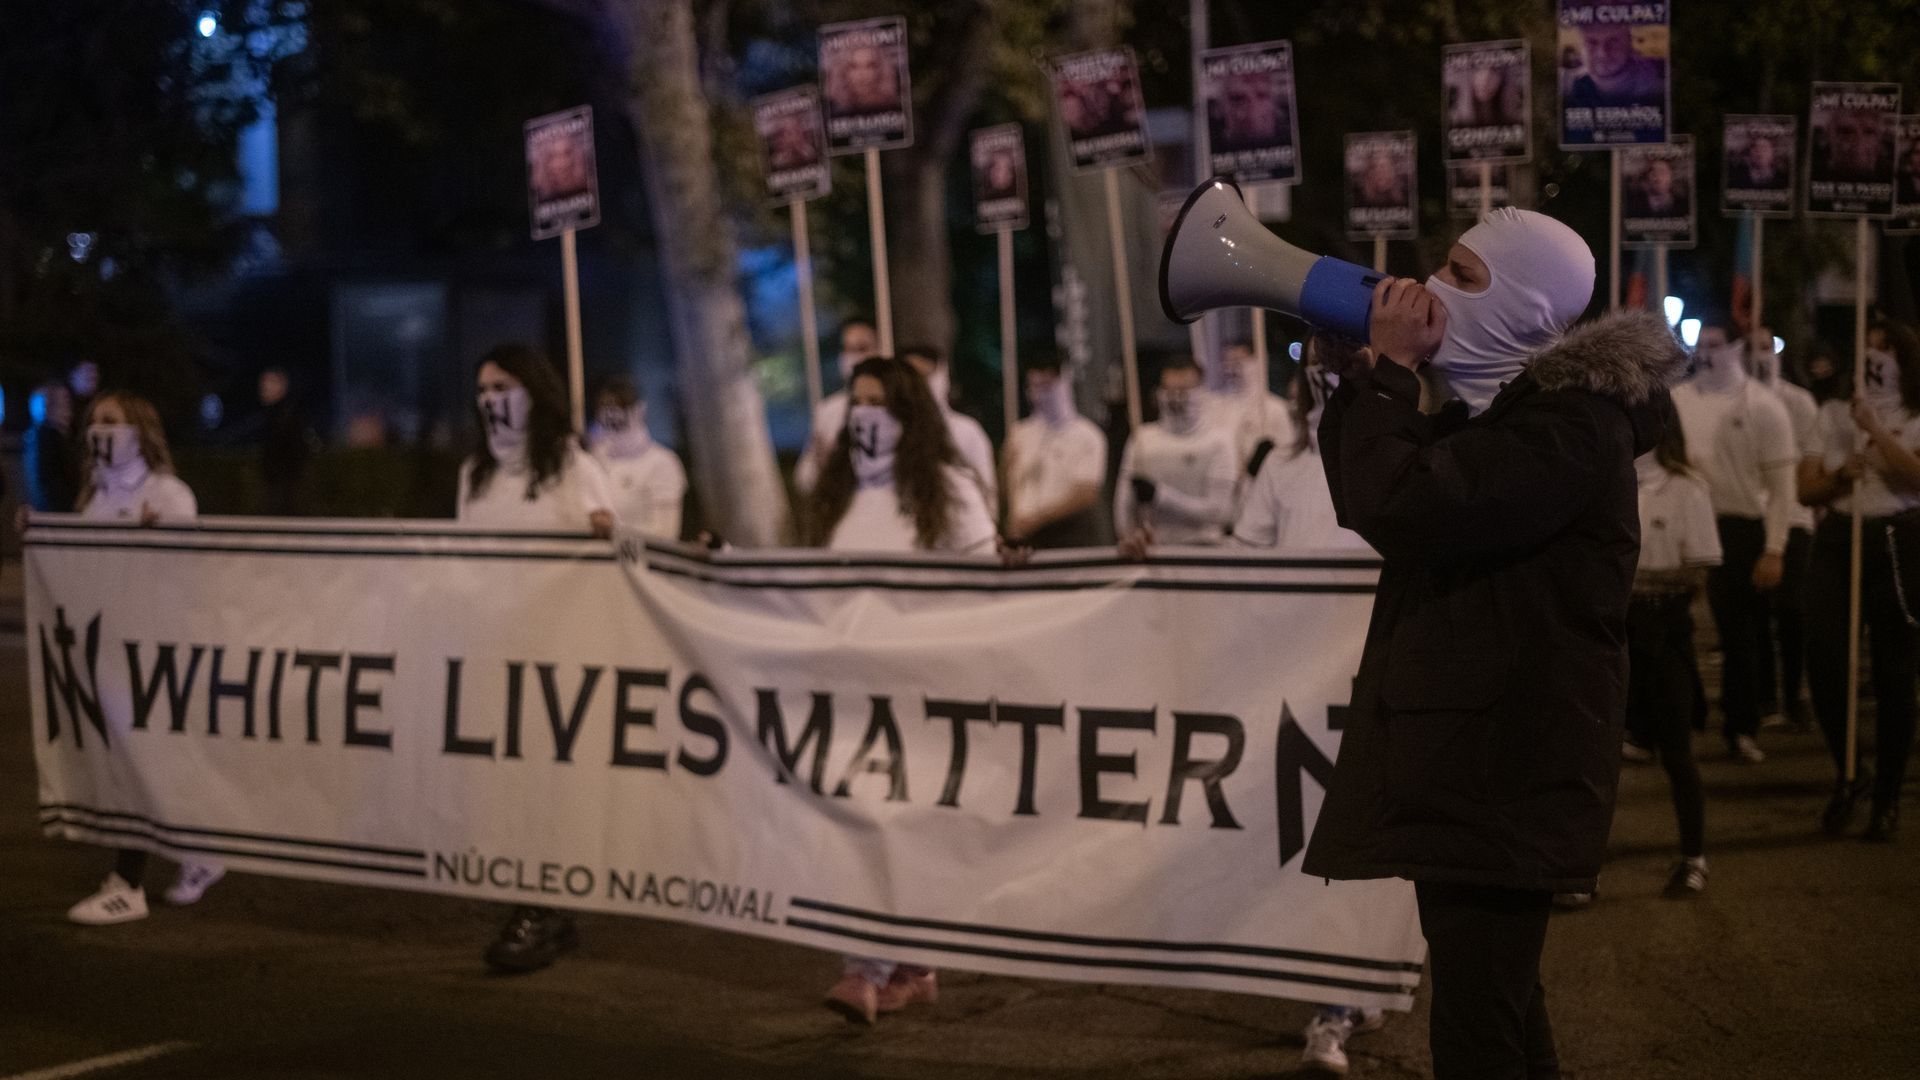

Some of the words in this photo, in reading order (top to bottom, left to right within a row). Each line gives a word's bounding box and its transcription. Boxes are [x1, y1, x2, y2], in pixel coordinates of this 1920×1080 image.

[1595, 4, 1664, 23] CULPA?
[123, 639, 397, 751] WHITE
[441, 656, 731, 778] LIVES
[752, 687, 1246, 831] MATTER
[434, 846, 595, 897] NÚCLEO
[606, 868, 779, 926] NACIONAL
